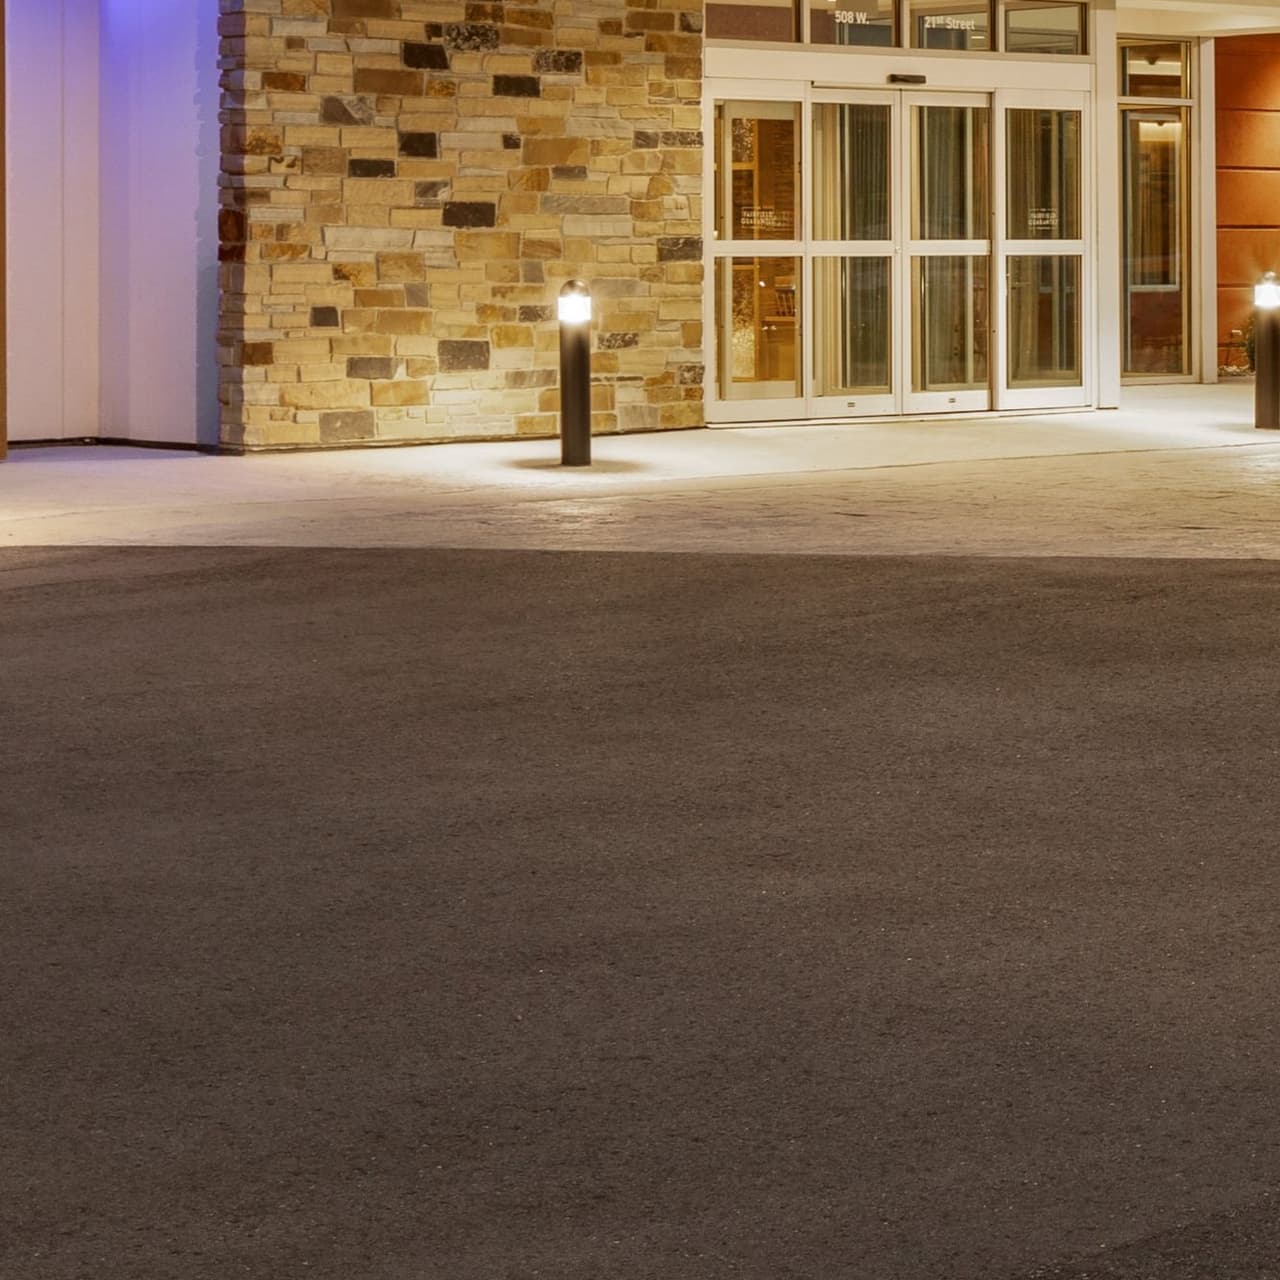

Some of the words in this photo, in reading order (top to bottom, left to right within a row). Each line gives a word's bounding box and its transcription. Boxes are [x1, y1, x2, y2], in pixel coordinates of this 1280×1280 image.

[834, 10, 854, 24] 508
[856, 11, 870, 25] W.
[924, 15, 944, 29] 21st
[945, 16, 976, 30] Street
